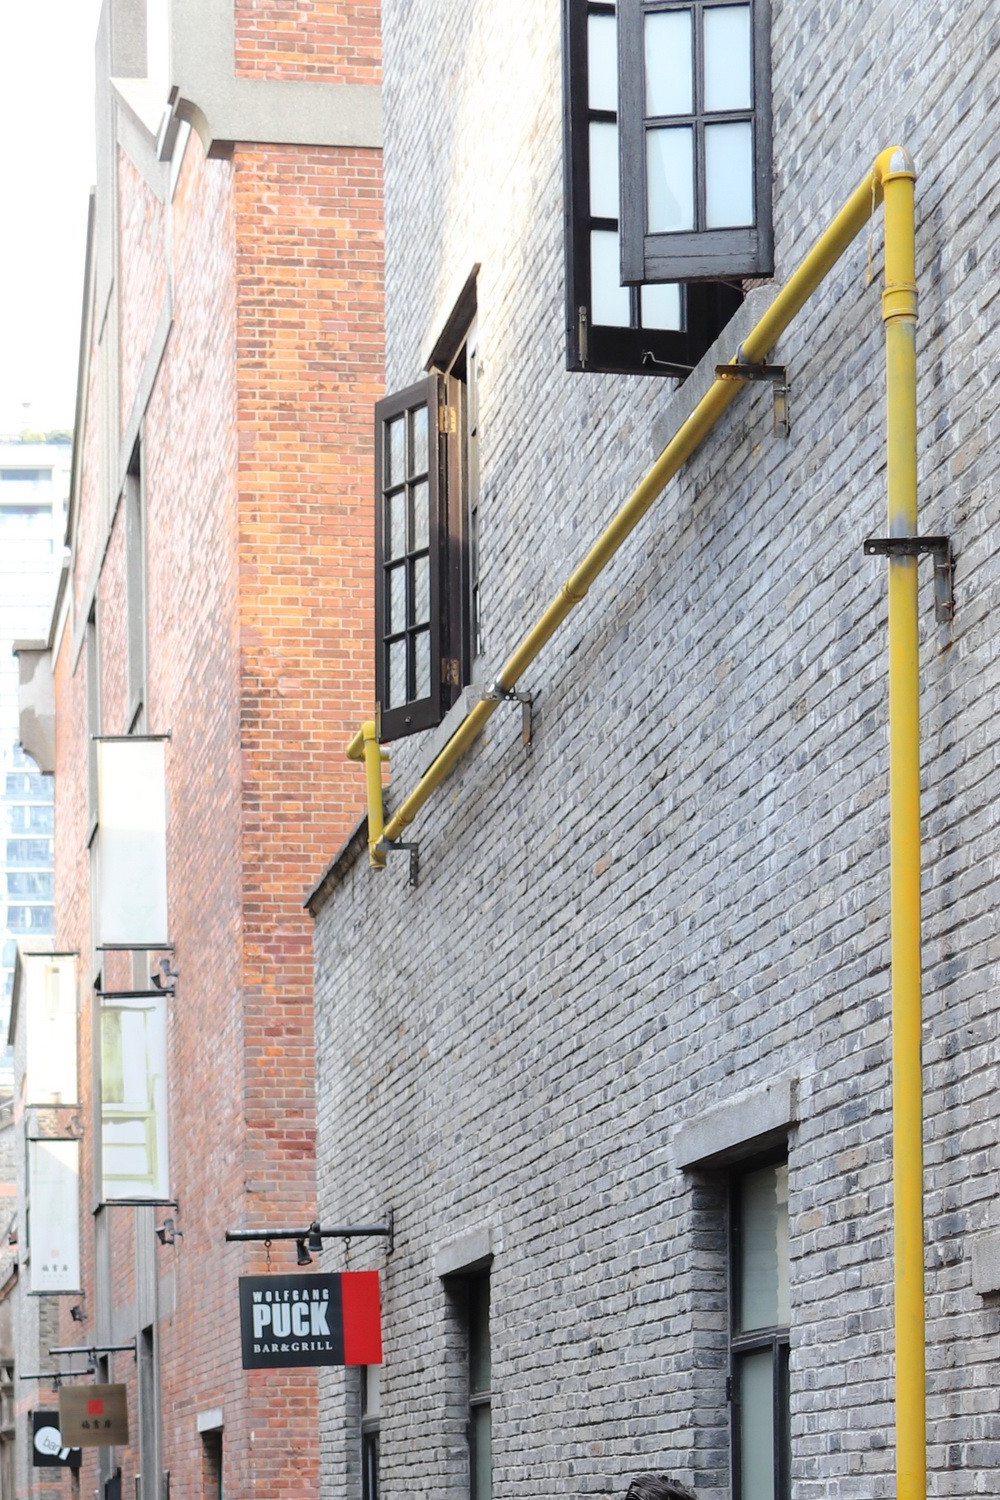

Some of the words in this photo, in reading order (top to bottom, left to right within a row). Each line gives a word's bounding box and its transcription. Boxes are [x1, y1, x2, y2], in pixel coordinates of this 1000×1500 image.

[252, 1289, 330, 1303] WOLFGANG
[252, 1301, 331, 1339] PUCK
[253, 1341, 333, 1354] BAR&GRILL
